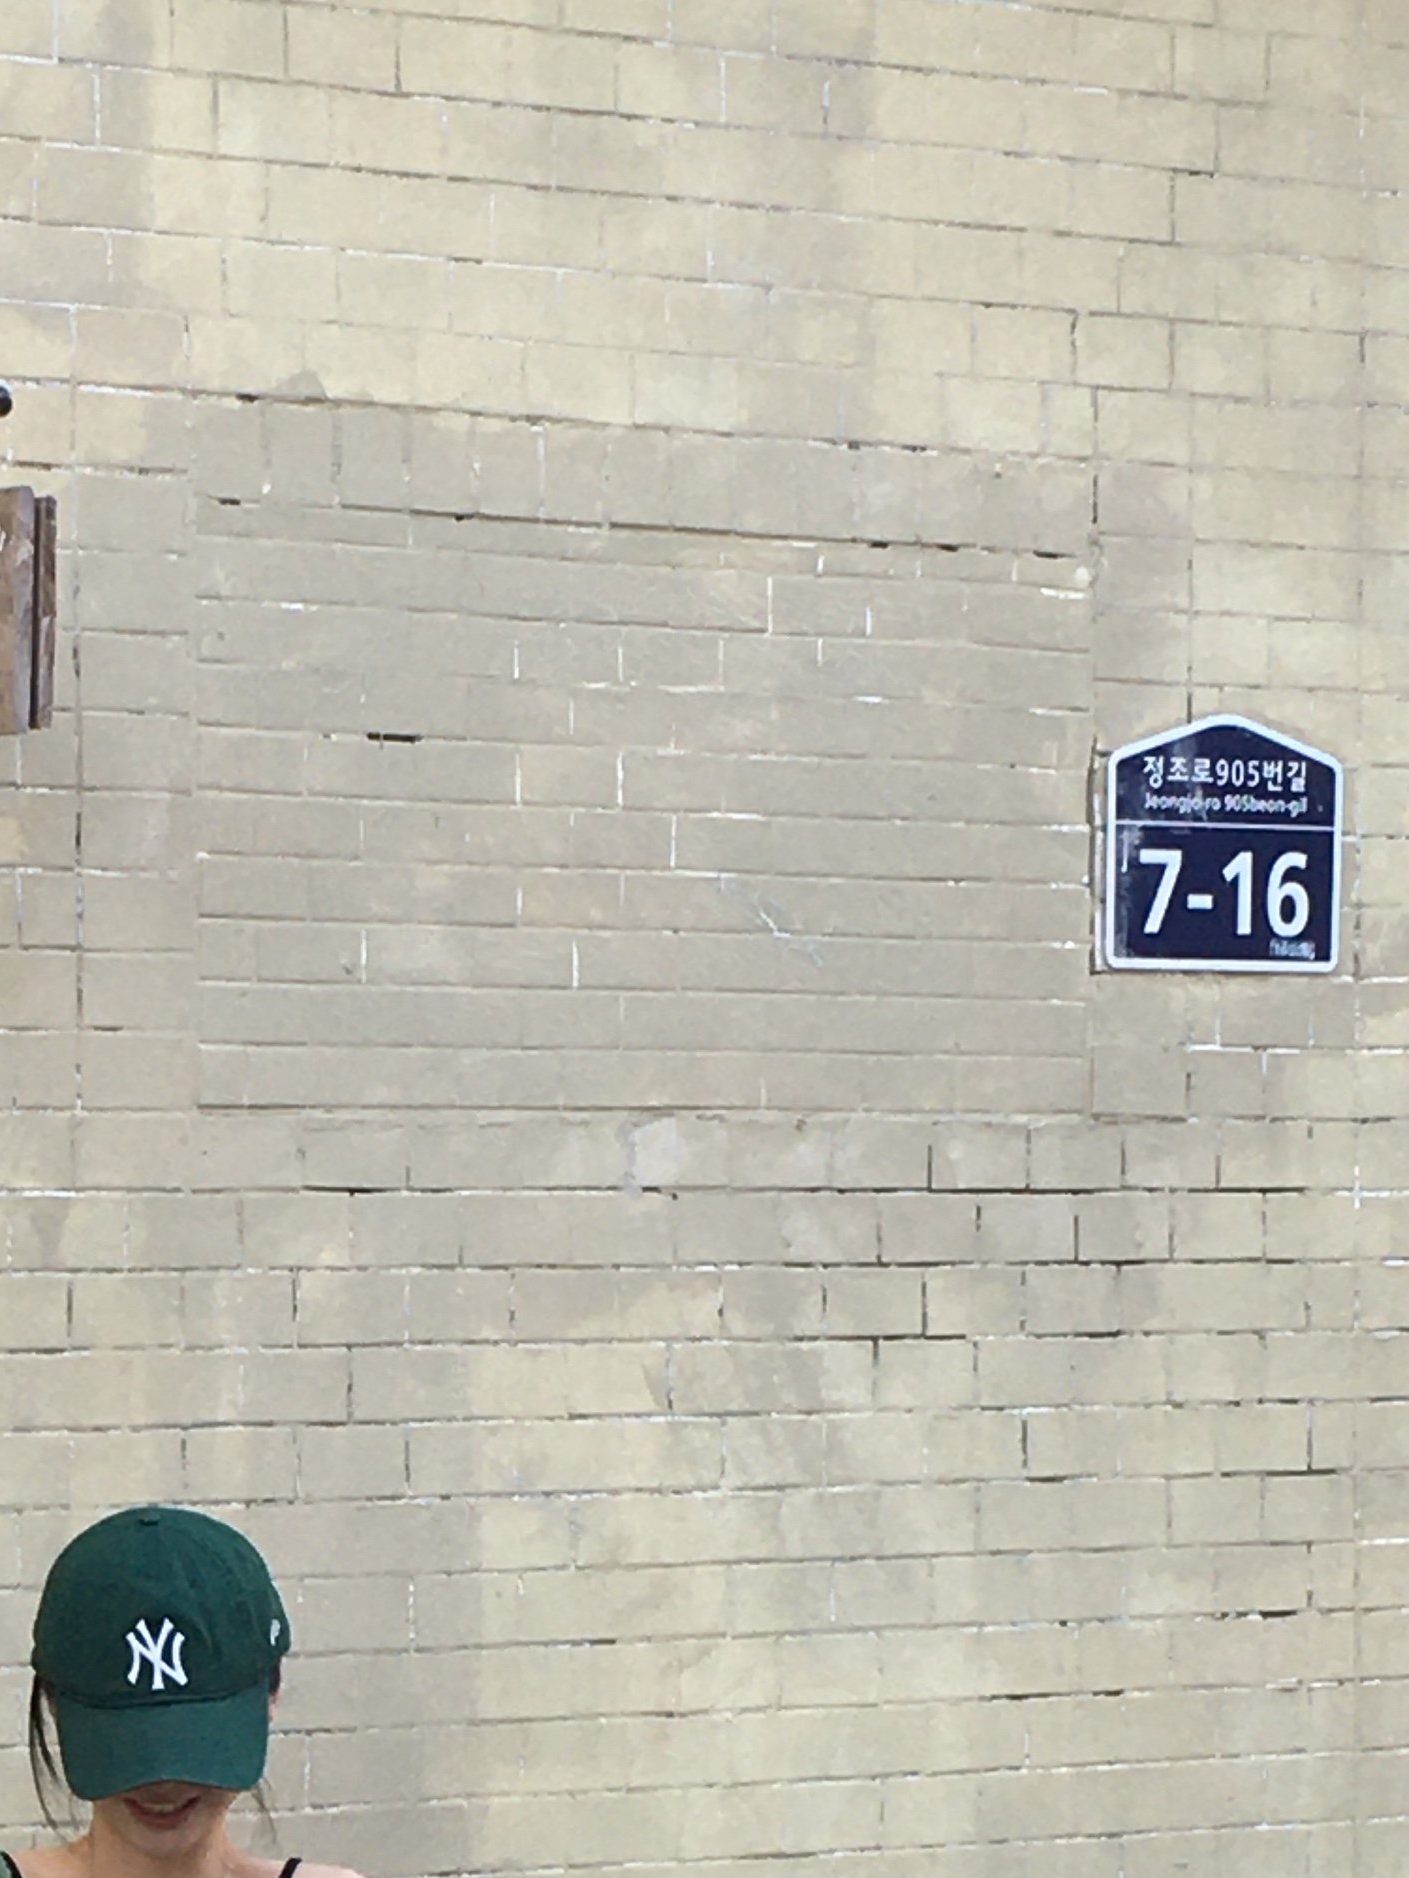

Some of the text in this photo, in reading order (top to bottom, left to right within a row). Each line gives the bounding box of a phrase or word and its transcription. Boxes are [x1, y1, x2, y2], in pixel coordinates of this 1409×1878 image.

[1142, 755, 1307, 792] 정조로905번길
[1139, 848, 1310, 938] 7-16
[125, 1617, 189, 1690] NY
